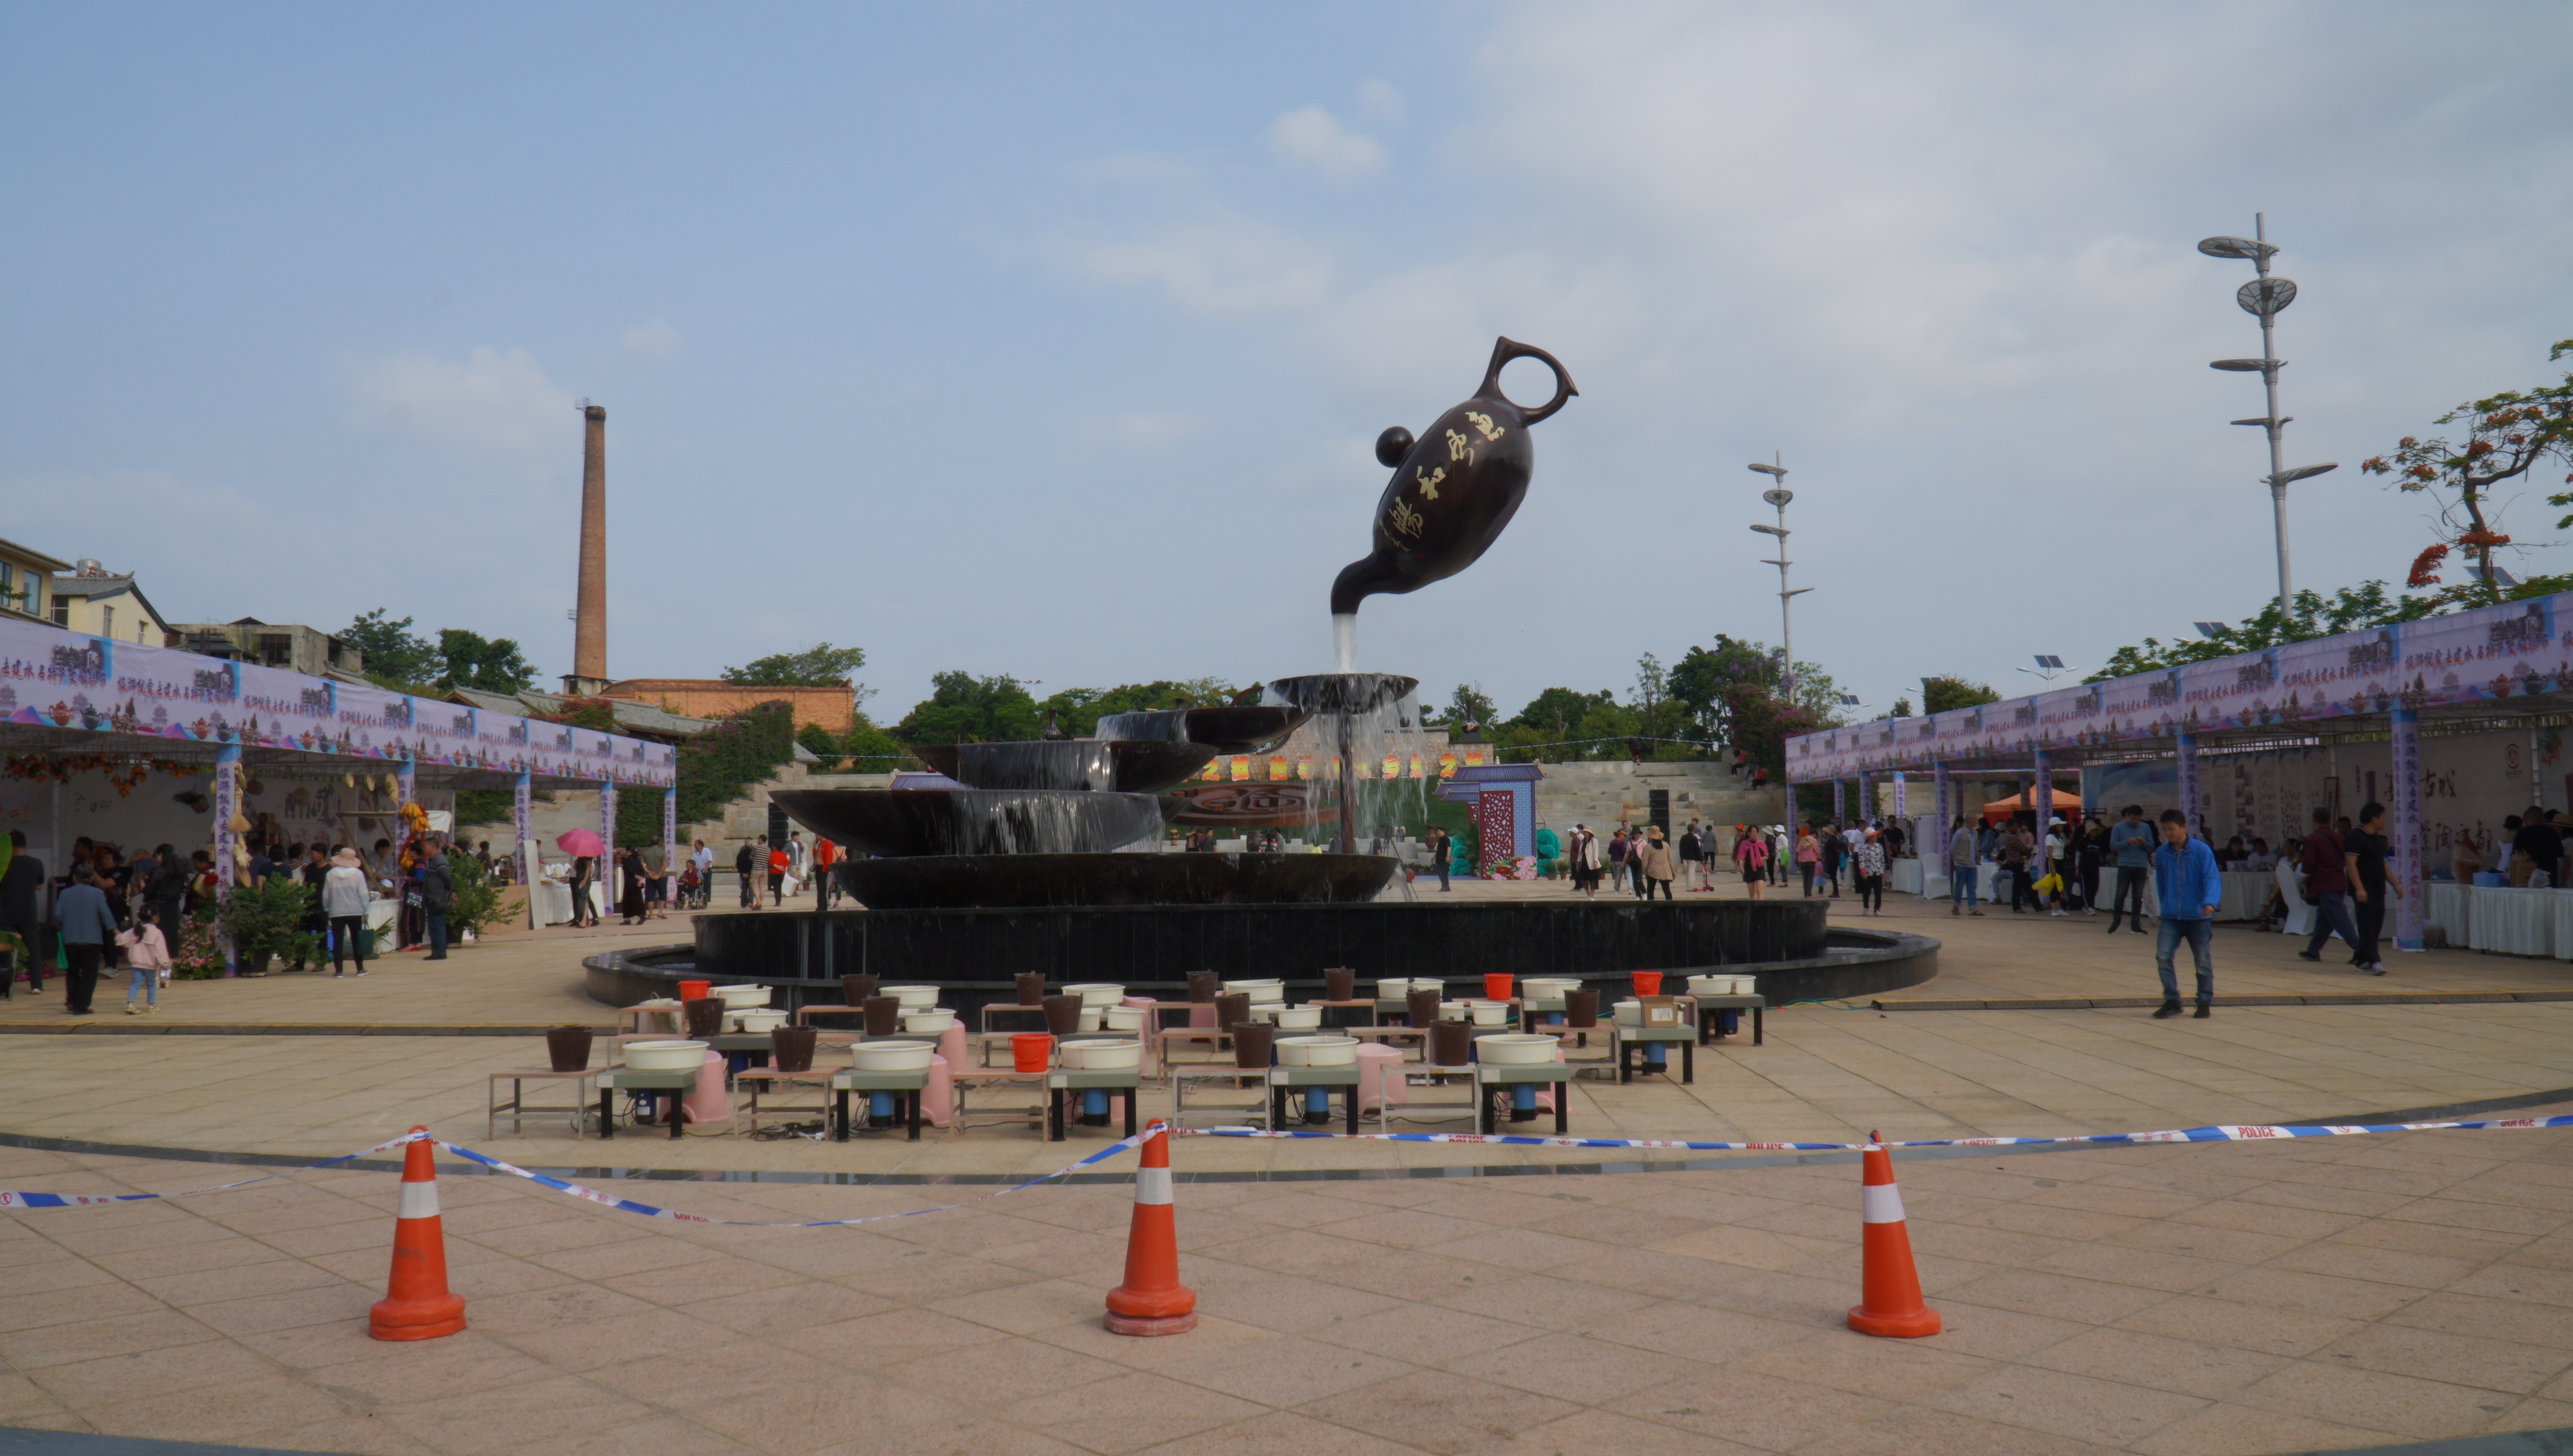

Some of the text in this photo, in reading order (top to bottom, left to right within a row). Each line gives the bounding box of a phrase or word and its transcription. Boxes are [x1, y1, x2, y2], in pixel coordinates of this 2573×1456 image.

[2405, 733, 2418, 824] 旅游就爱去建水
[2237, 1127, 2276, 1138] POLICE
